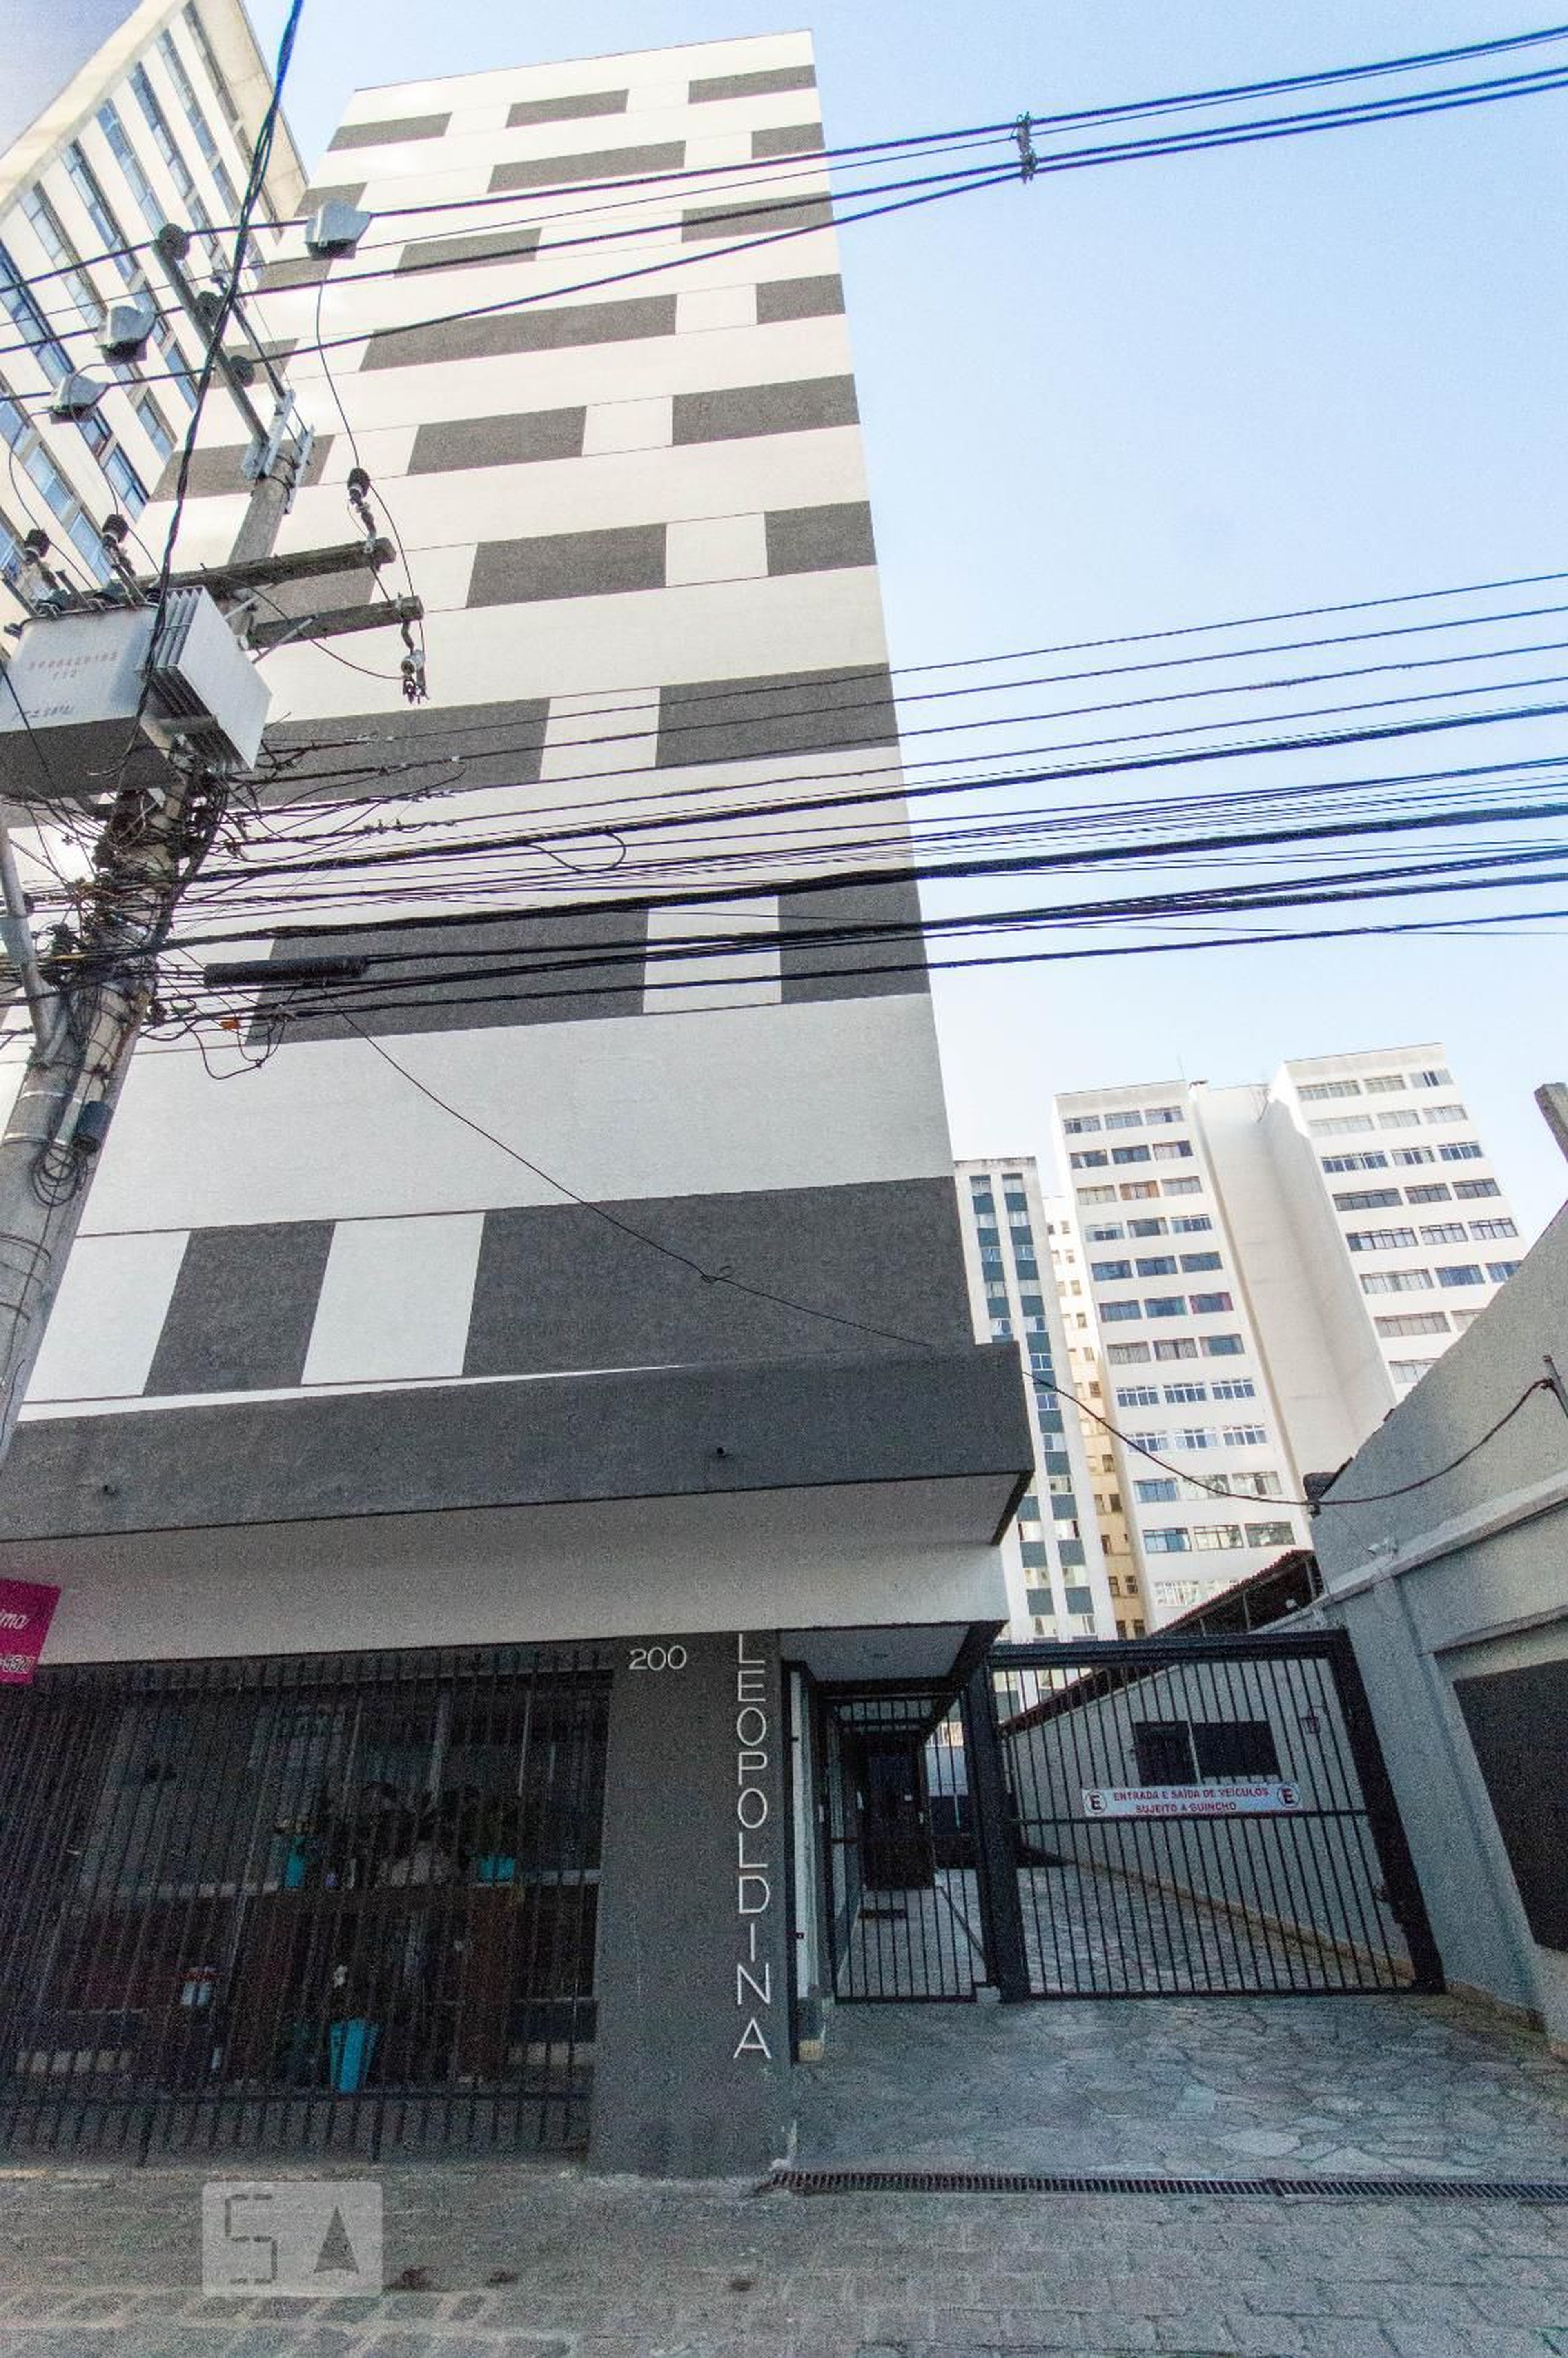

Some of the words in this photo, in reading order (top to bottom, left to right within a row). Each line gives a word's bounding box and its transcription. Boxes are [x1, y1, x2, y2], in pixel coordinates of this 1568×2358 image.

[629, 1645, 687, 1671] 200
[1090, 1795, 1102, 1810] E
[1114, 1790, 1159, 1801] ENTRADA
[1163, 1791, 1169, 1799] E
[1203, 1789, 1214, 1798] DE
[1281, 1788, 1295, 1804] E
[1135, 1804, 1178, 1813] SUJEITO
[1189, 1801, 1236, 1812] GUINCHO
[734, 1633, 772, 2059] LEOPOLDINA
